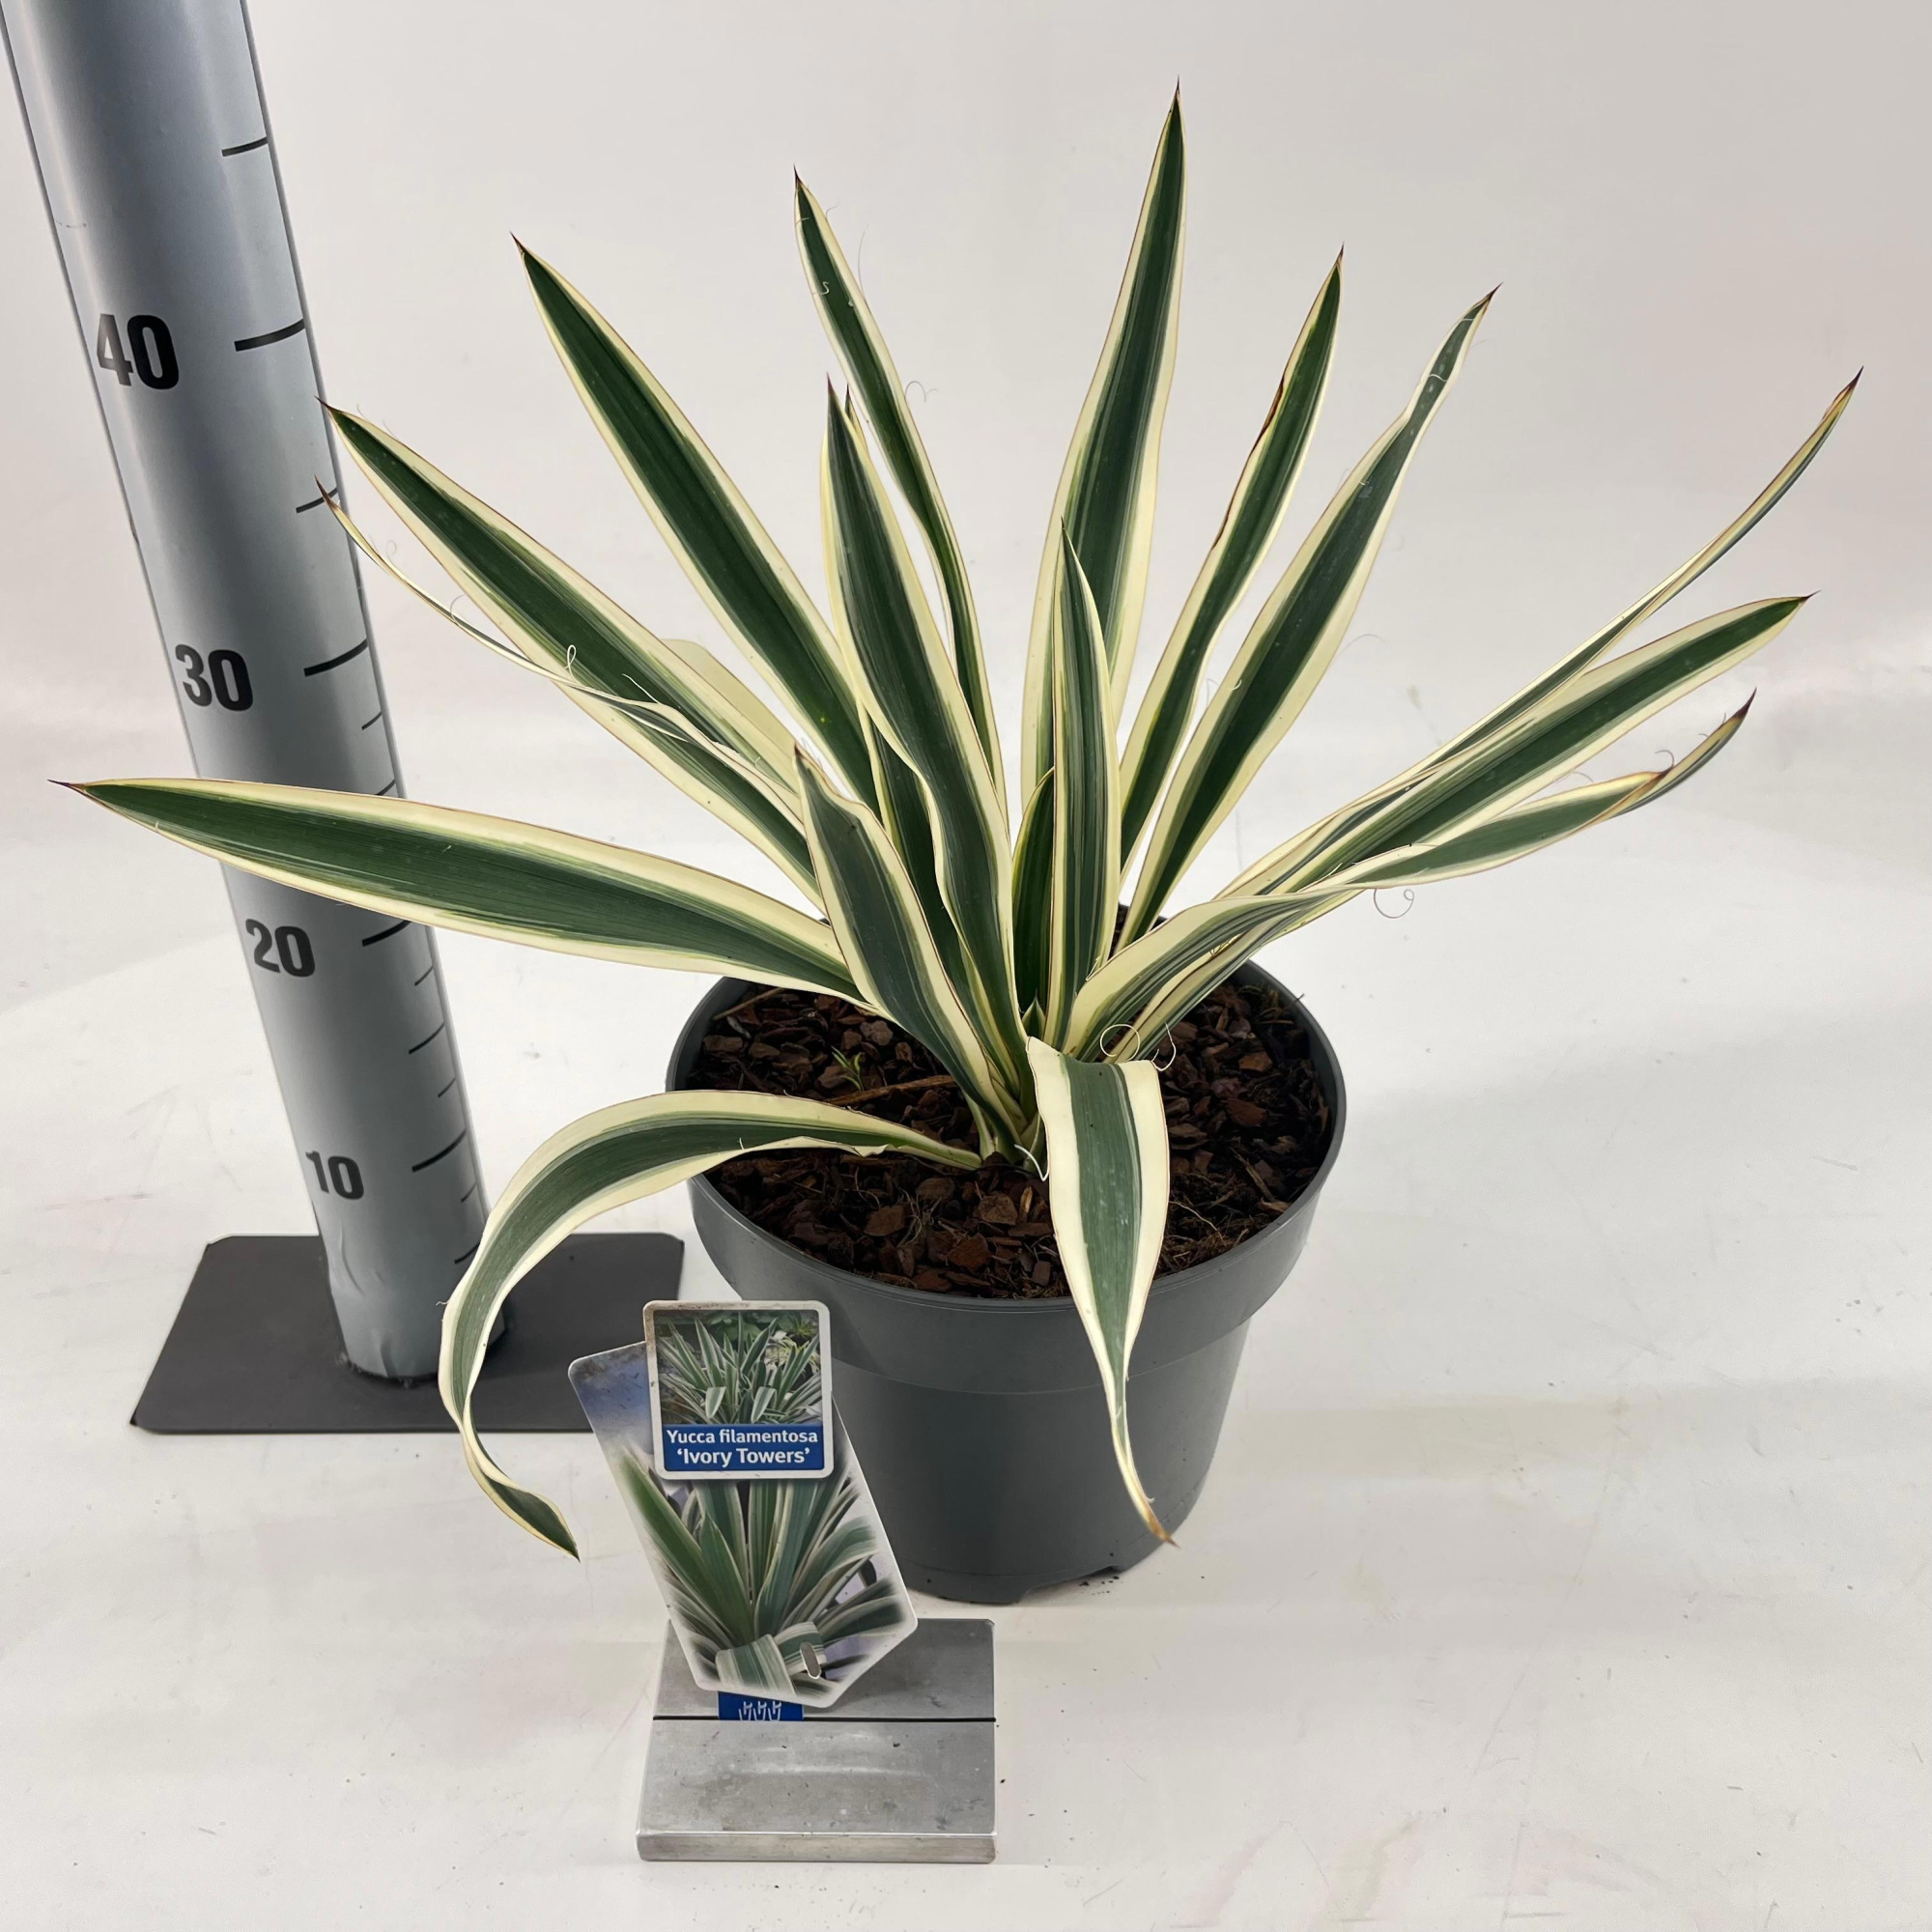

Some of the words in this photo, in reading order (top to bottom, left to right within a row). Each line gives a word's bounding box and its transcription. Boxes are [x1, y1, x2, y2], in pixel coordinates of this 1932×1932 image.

[96, 314, 180, 390] 40
[175, 643, 254, 712] 30
[245, 918, 316, 978] 20
[304, 1150, 365, 1201] 10
[666, 1429, 716, 1444] Yucca
[719, 1428, 818, 1443] filamentosa
